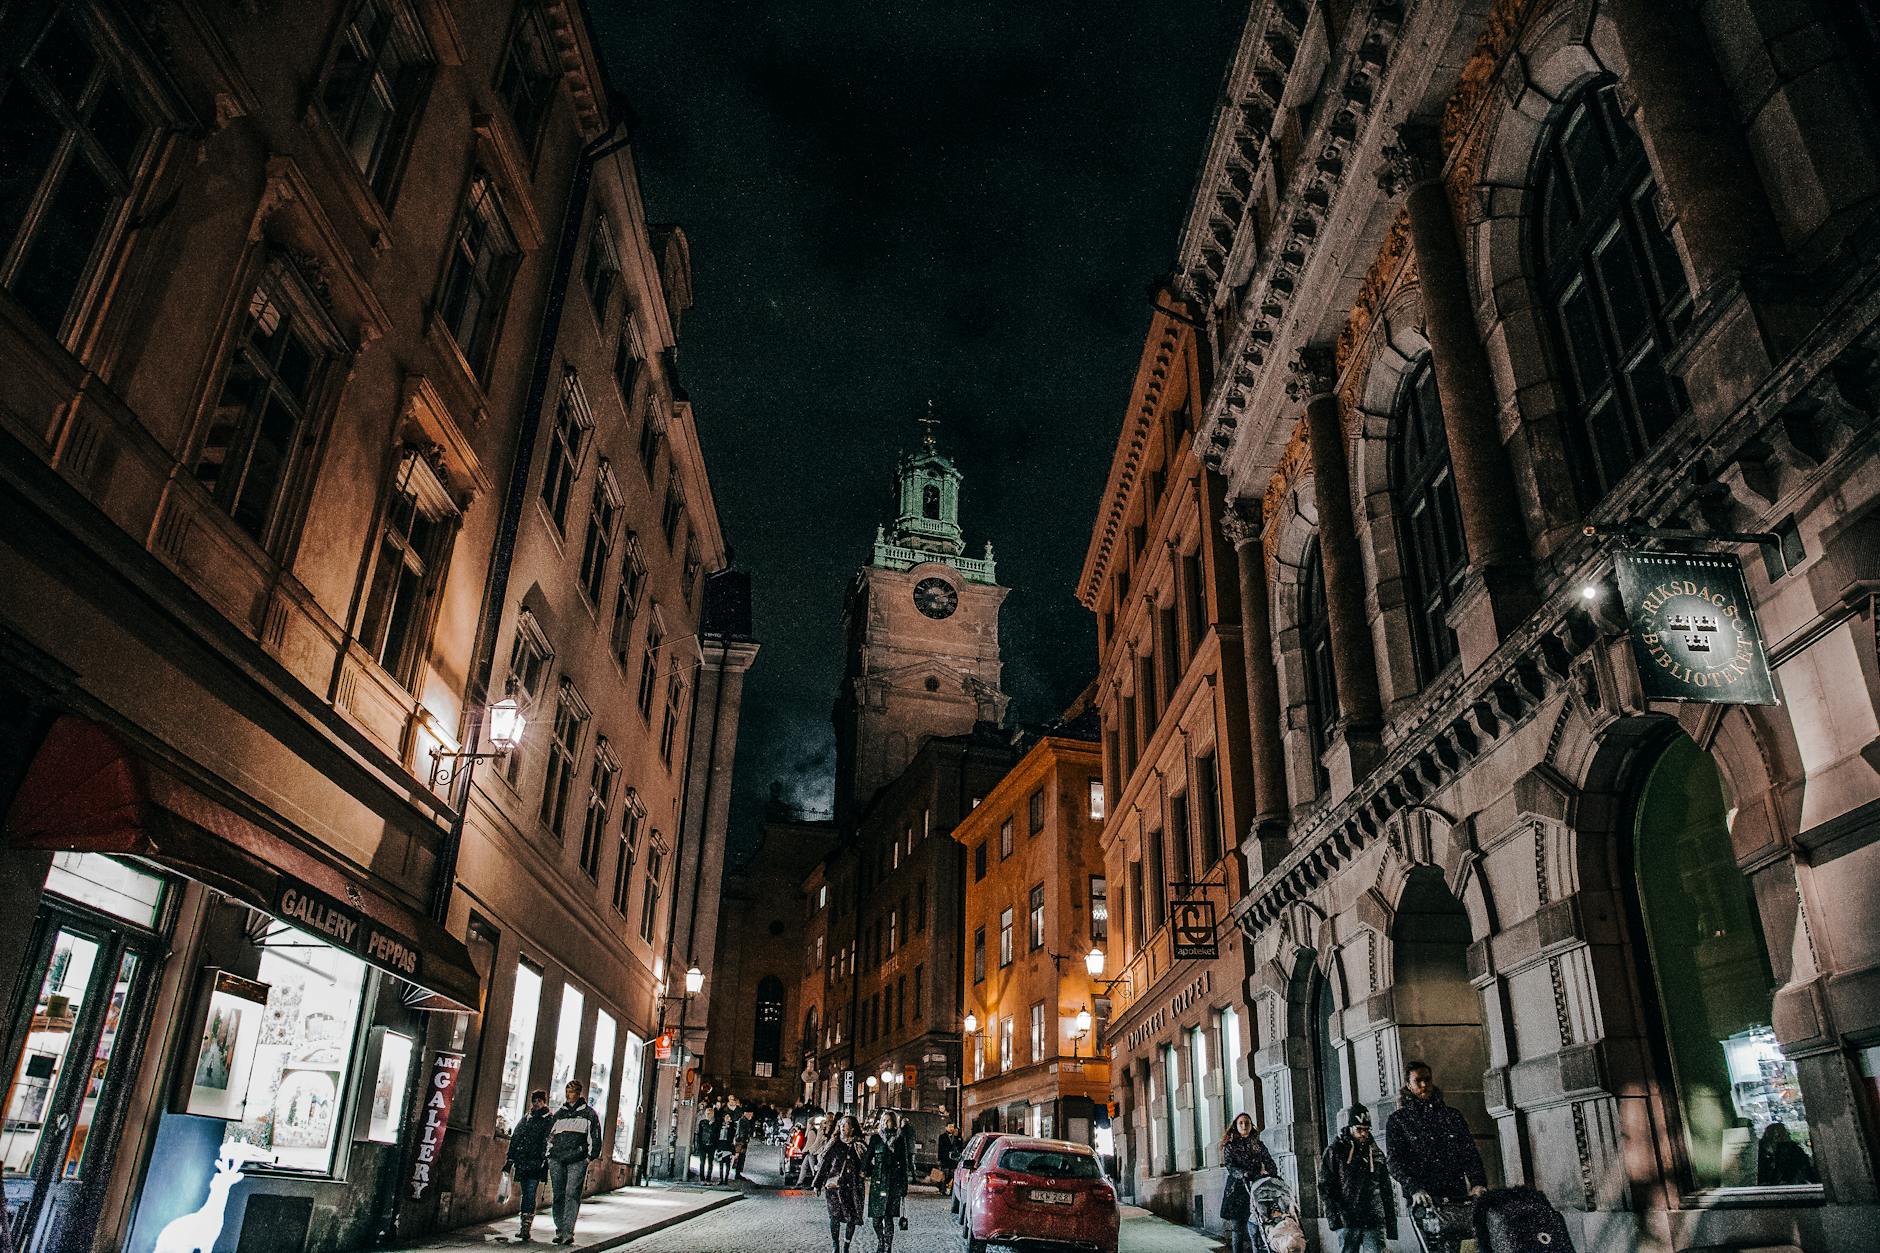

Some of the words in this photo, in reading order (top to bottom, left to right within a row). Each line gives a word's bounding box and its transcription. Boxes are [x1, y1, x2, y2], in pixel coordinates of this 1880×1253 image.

[1625, 556, 1677, 566] VERIGES
[1685, 559, 1734, 569] RIKSDAG
[1641, 580, 1738, 618] RIKSDAGS
[1641, 631, 1754, 688] BIBLIOTEKET
[280, 887, 358, 945] GALLERY
[367, 930, 417, 974] PEPPAS
[1177, 946, 1217, 957] apoteket
[1127, 1007, 1166, 1052] APOTEKET
[1170, 970, 1211, 1019] KORPEN
[433, 1055, 462, 1068] ART
[411, 1070, 452, 1200] GALLERY
